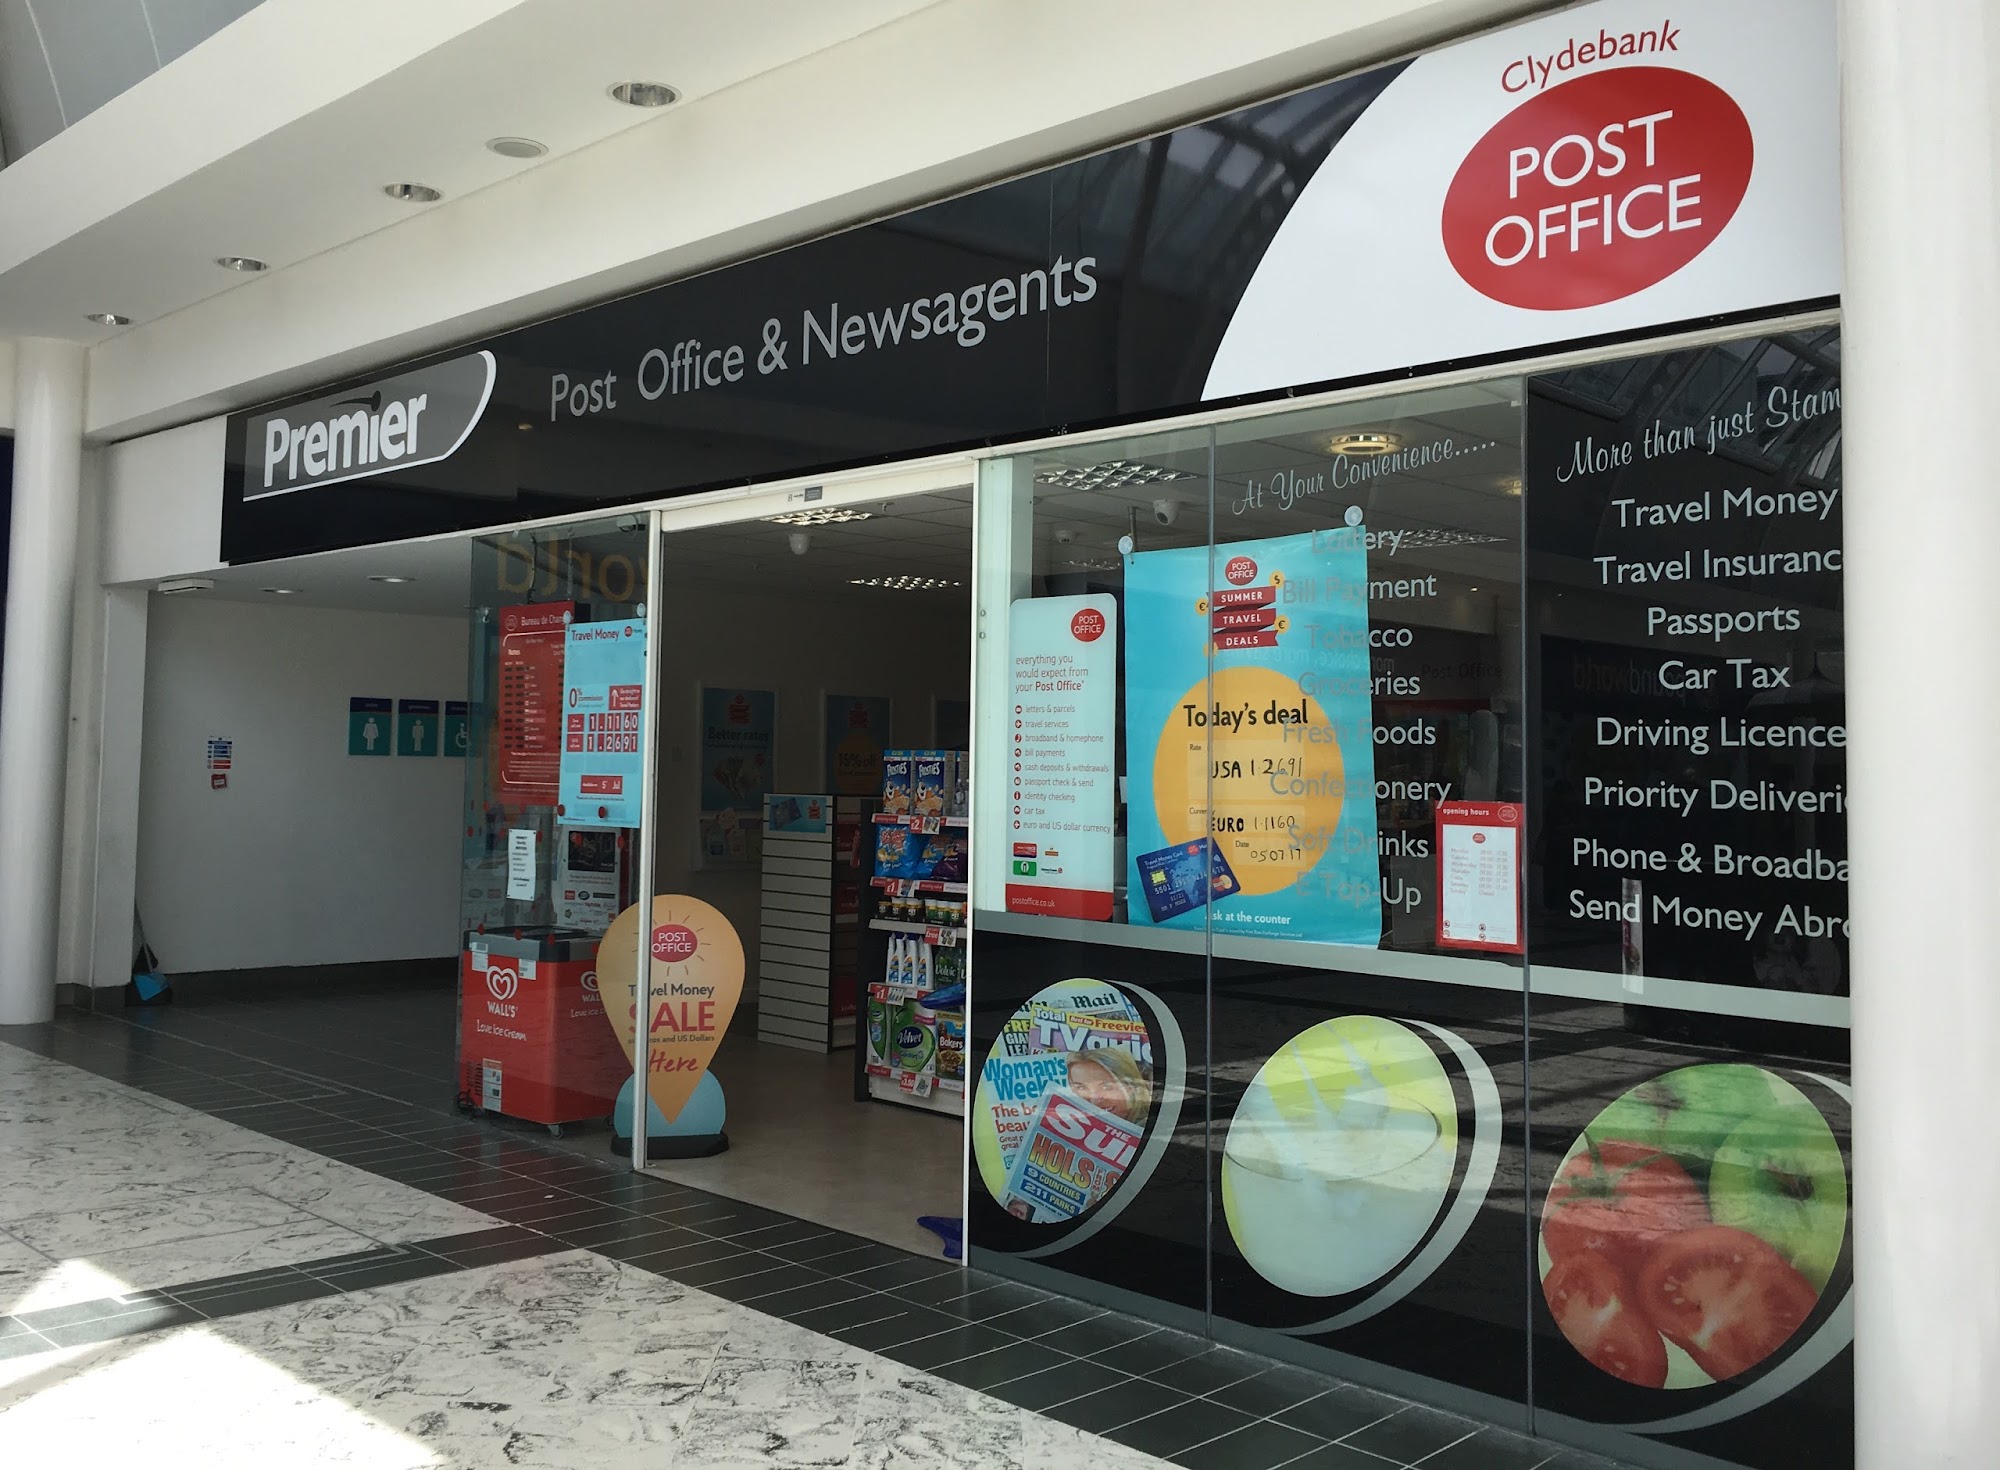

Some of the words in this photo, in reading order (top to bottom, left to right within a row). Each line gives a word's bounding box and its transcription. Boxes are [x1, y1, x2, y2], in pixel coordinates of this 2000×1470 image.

[1501, 19, 1681, 93] Clydebank
[1509, 109, 1673, 199] POST
[1484, 173, 1702, 267] OFFICE
[550, 368, 617, 422] Post
[636, 339, 744, 400] Office
[757, 317, 789, 375] &
[802, 254, 1097, 365] Newsagents
[263, 391, 427, 487] Premier
[1556, 436, 1633, 483] More
[1643, 419, 1696, 460] than
[1706, 401, 1755, 455] just
[1232, 479, 1263, 515] At
[1270, 469, 1324, 511] Your
[1611, 491, 1711, 527] Travel
[1723, 487, 1839, 520] Money
[1312, 527, 1405, 556] Lottery
[1232, 561, 1250, 571] POST
[1593, 550, 1691, 584] Travel
[1228, 570, 1254, 579] OFFICE
[1221, 591, 1263, 603] SUMMER
[1282, 577, 1317, 605] Bill
[1325, 574, 1437, 607] Payment
[521, 616, 540, 626] Bureau
[1078, 615, 1099, 624] POST
[1223, 613, 1261, 624] TRAVEL
[1648, 606, 1801, 642] Passports
[571, 629, 593, 642] Travel
[595, 628, 620, 642] Money
[1073, 624, 1101, 634] OFFICE
[1304, 623, 1413, 649] Tobacco
[1226, 635, 1259, 646] DEALS
[1015, 654, 1056, 666] everything
[1058, 655, 1073, 665] you
[1015, 668, 1039, 678] would
[1041, 668, 1066, 679] expect
[1069, 667, 1089, 677] from
[1658, 660, 1717, 690] Car
[1726, 658, 1791, 689] Tax
[1015, 684, 1033, 694] your
[1035, 681, 1054, 691] Post
[1298, 670, 1421, 696] Groceries
[1025, 705, 1045, 713] letters
[1053, 705, 1075, 714] parcels
[1183, 701, 1257, 733] Today's
[1263, 698, 1308, 725] deal
[1025, 720, 1043, 728] travel
[1044, 720, 1069, 728] services
[1283, 717, 1350, 745] Fresh
[1360, 718, 1436, 745] Foods
[1025, 734, 1057, 742] broadband
[1066, 734, 1104, 743] homephone
[1597, 717, 1710, 755] Driving
[1025, 749, 1034, 757] bill
[1035, 749, 1065, 758] payments
[1189, 743, 1202, 751] Rate
[1040, 764, 1064, 772] deposits
[1072, 764, 1109, 773] withdrawals
[1024, 778, 1051, 787] passport
[1052, 778, 1070, 787] check
[1078, 779, 1094, 787] send
[1270, 770, 1452, 809] Confectionery
[1024, 791, 1047, 801] identity
[1048, 792, 1075, 803] checking
[1585, 776, 1699, 817] Priority
[1024, 807, 1034, 815] car
[1035, 807, 1045, 815] tax
[1443, 807, 1469, 816] opening
[1470, 808, 1490, 816] hours
[1039, 821, 1051, 830] and
[1052, 821, 1062, 830] US
[1063, 822, 1081, 831] dollar
[1082, 824, 1111, 834] currency
[1235, 840, 1250, 848] Date
[1288, 824, 1338, 852] Soft
[1343, 829, 1429, 858] Drinks
[1573, 837, 1667, 871] Phone
[1677, 842, 1703, 873] &
[1011, 896, 1056, 907] postoffice.co.uk
[1225, 912, 1234, 921] at
[1236, 911, 1252, 922] the
[1254, 915, 1291, 925] counter
[1569, 889, 1641, 923] Send
[1653, 894, 1763, 941] Money
[658, 932, 688, 942] POST
[651, 942, 692, 953] OFFICE
[671, 983, 715, 999] Money
[1071, 993, 1118, 1008] Mail
[487, 1001, 516, 1018] WALL'S
[1034, 1007, 1066, 1022] Total
[662, 1035, 675, 1043] and
[689, 1034, 715, 1042] Dollars
[897, 1029, 922, 1045] Velvet
[940, 1037, 963, 1049] Bakers
[649, 1049, 698, 1074] Here
[984, 1056, 1067, 1082] Woman's
[991, 1103, 1019, 1118] The
[999, 1135, 1019, 1143] Great
[1104, 1124, 1132, 1141] THE
[1027, 1132, 1095, 1190] HOLS
[1027, 1166, 1039, 1179] 9
[1038, 1173, 1082, 1200] COUNTRIES
[1023, 1181, 1048, 1199] 211
[1049, 1190, 1077, 1215] PARKS
